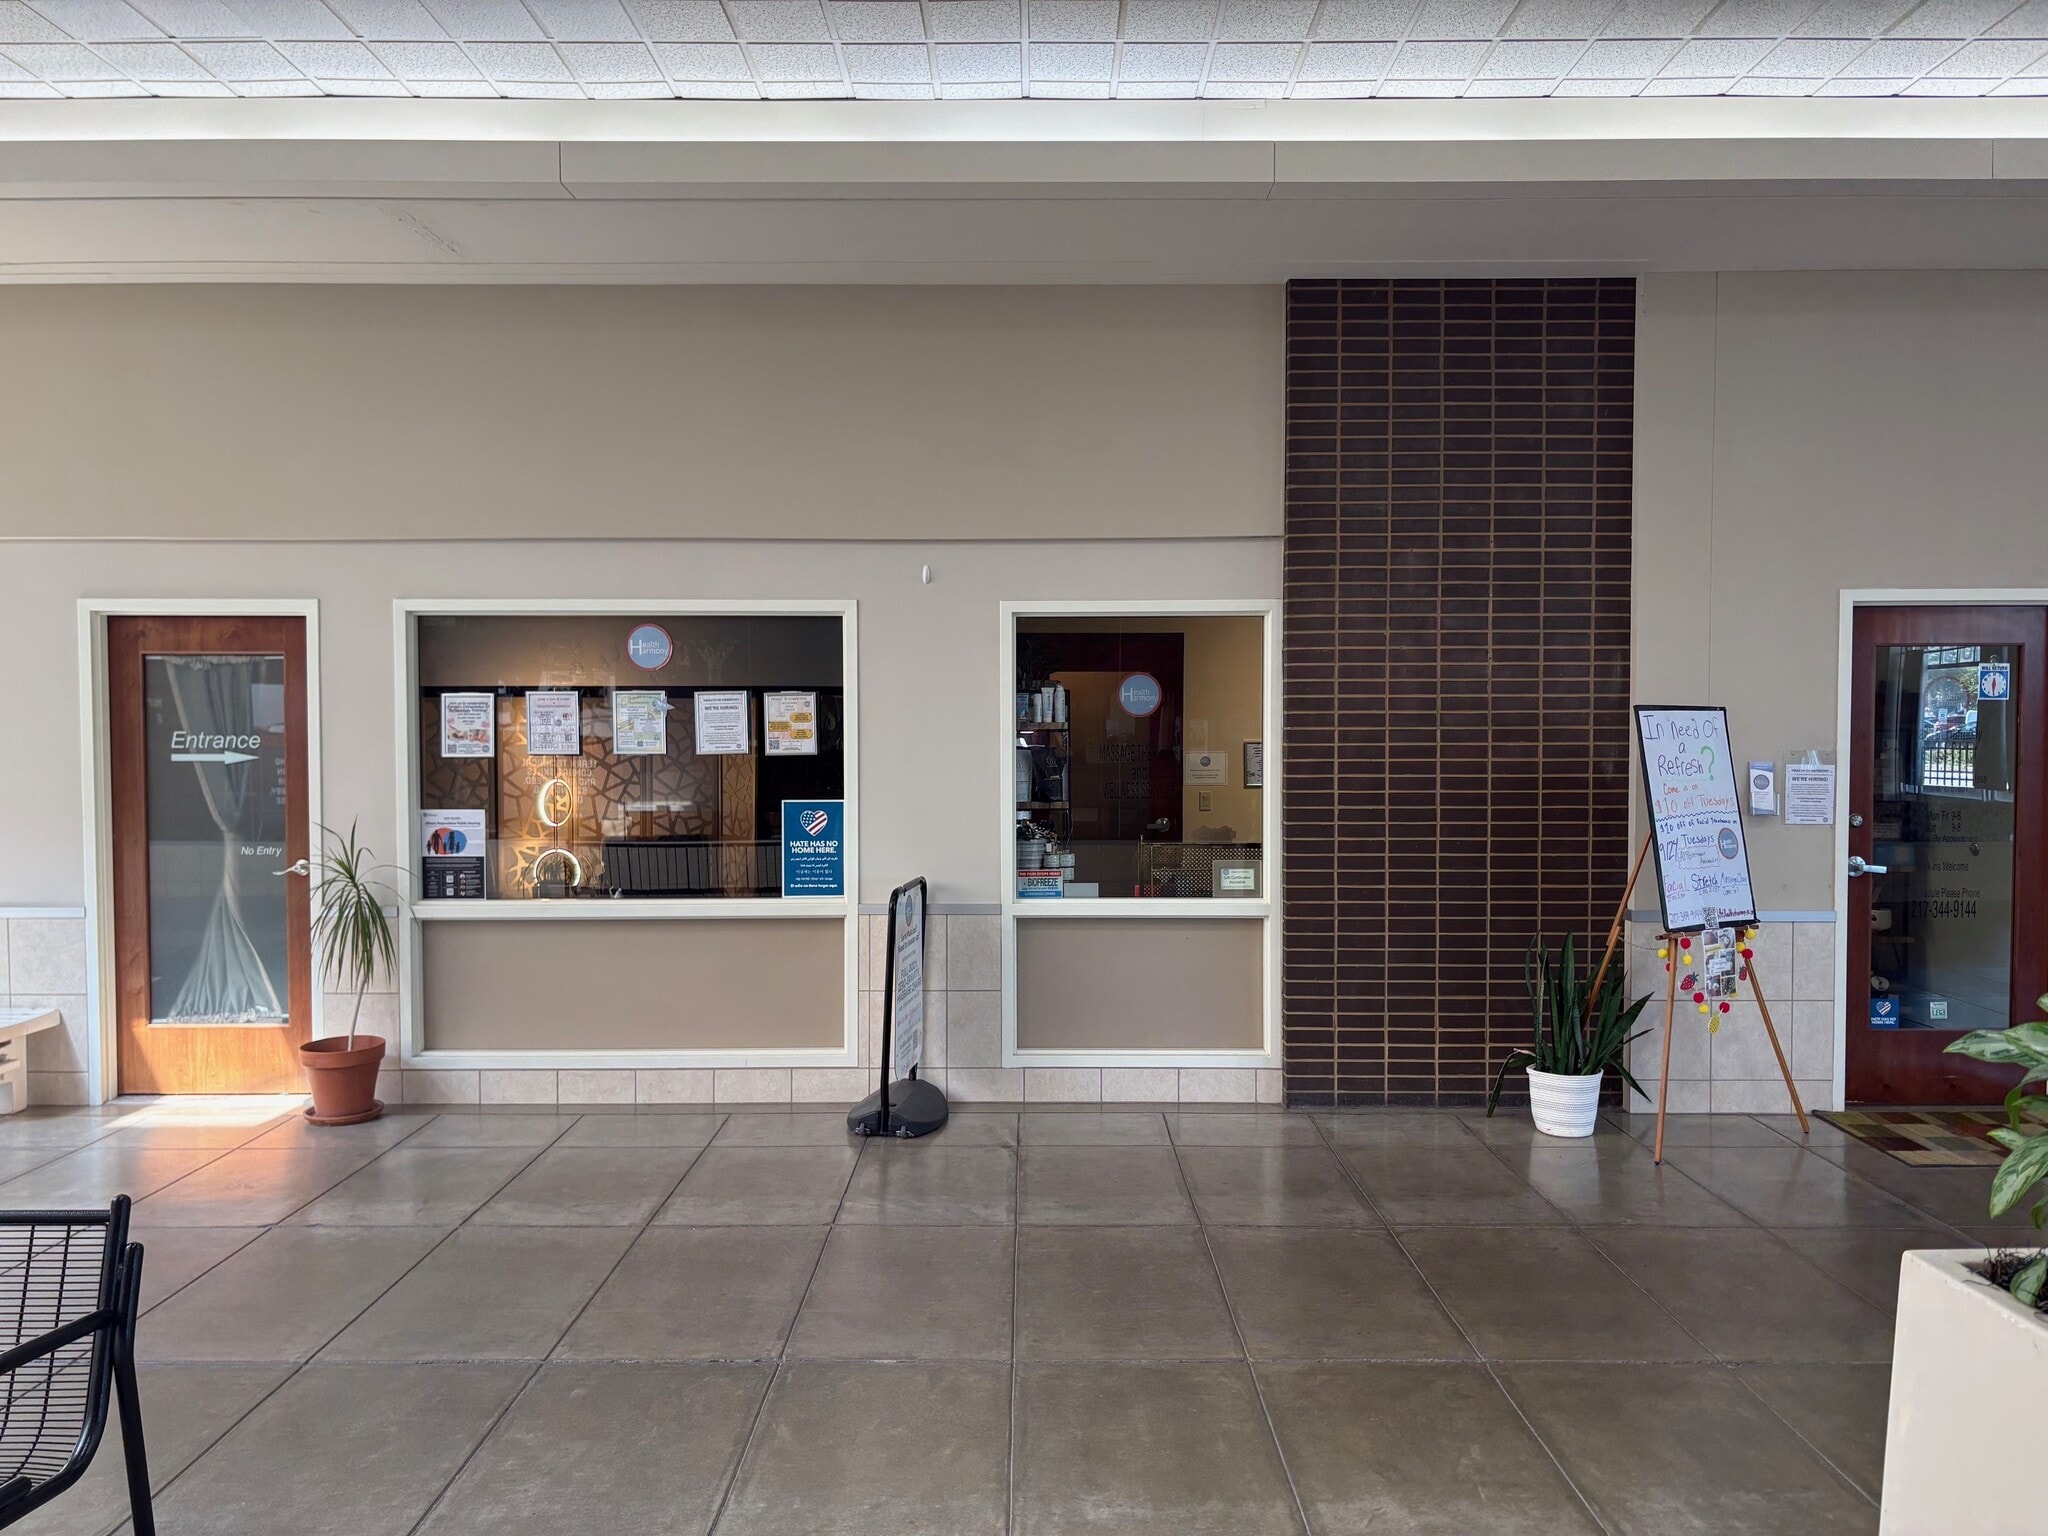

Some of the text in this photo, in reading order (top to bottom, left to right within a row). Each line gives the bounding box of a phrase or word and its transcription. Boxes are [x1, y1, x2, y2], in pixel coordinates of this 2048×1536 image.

[1643, 715, 1664, 740] In
[171, 730, 261, 749] Entrance
[1100, 744, 1135, 761] MASSAGE
[1678, 742, 1686, 754] a
[1131, 764, 1148, 780] and
[1655, 794, 1735, 815] $10 off Tuesdays
[1952, 811, 1962, 820] 9-8
[1660, 823, 1674, 834] $10
[1681, 834, 1714, 847] Tuesdays
[1943, 834, 1979, 843] Appointment
[241, 846, 281, 856] No Entry
[1942, 861, 1969, 871] Welcome
[1028, 878, 1059, 886] BIOFREEZE
[1941, 888, 1960, 898] Please
[1962, 888, 1980, 897] Phone
[1911, 900, 1977, 918] 217-344-9144
